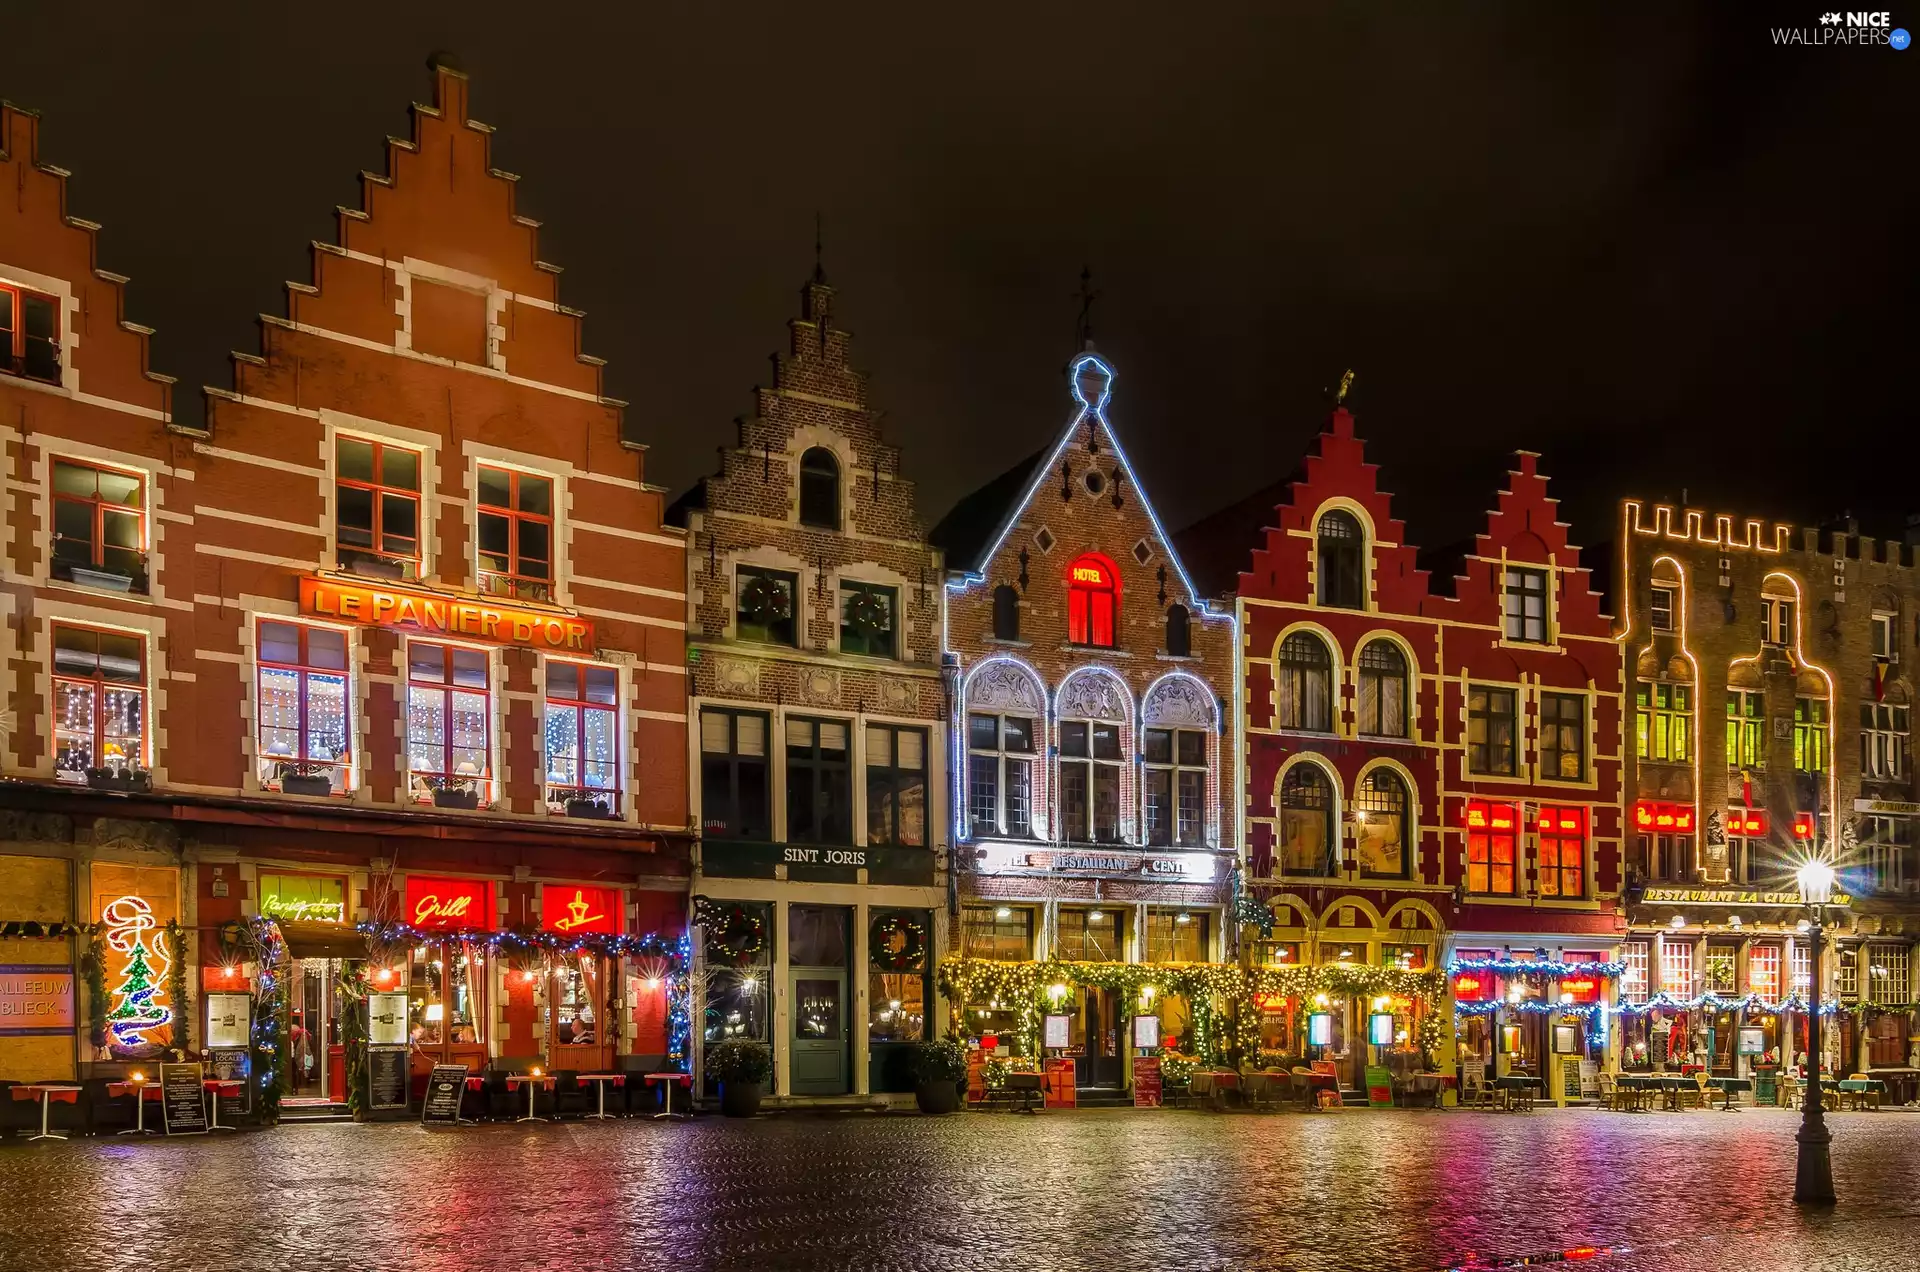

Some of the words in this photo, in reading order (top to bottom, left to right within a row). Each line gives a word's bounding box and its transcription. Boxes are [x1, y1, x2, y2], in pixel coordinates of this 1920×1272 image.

[1073, 567, 1102, 583] HOTEL
[315, 589, 359, 617] LE
[371, 592, 502, 637] PANIER
[512, 617, 587, 649] D'OR
[784, 848, 819, 862] SINT
[823, 850, 866, 865] JORIS
[1053, 856, 1128, 870] RESTAURANT
[1646, 889, 1736, 902] RESTAURANT
[1738, 891, 1758, 903] LA
[415, 894, 472, 925] Grill
[1, 1001, 56, 1016] BLIECK
